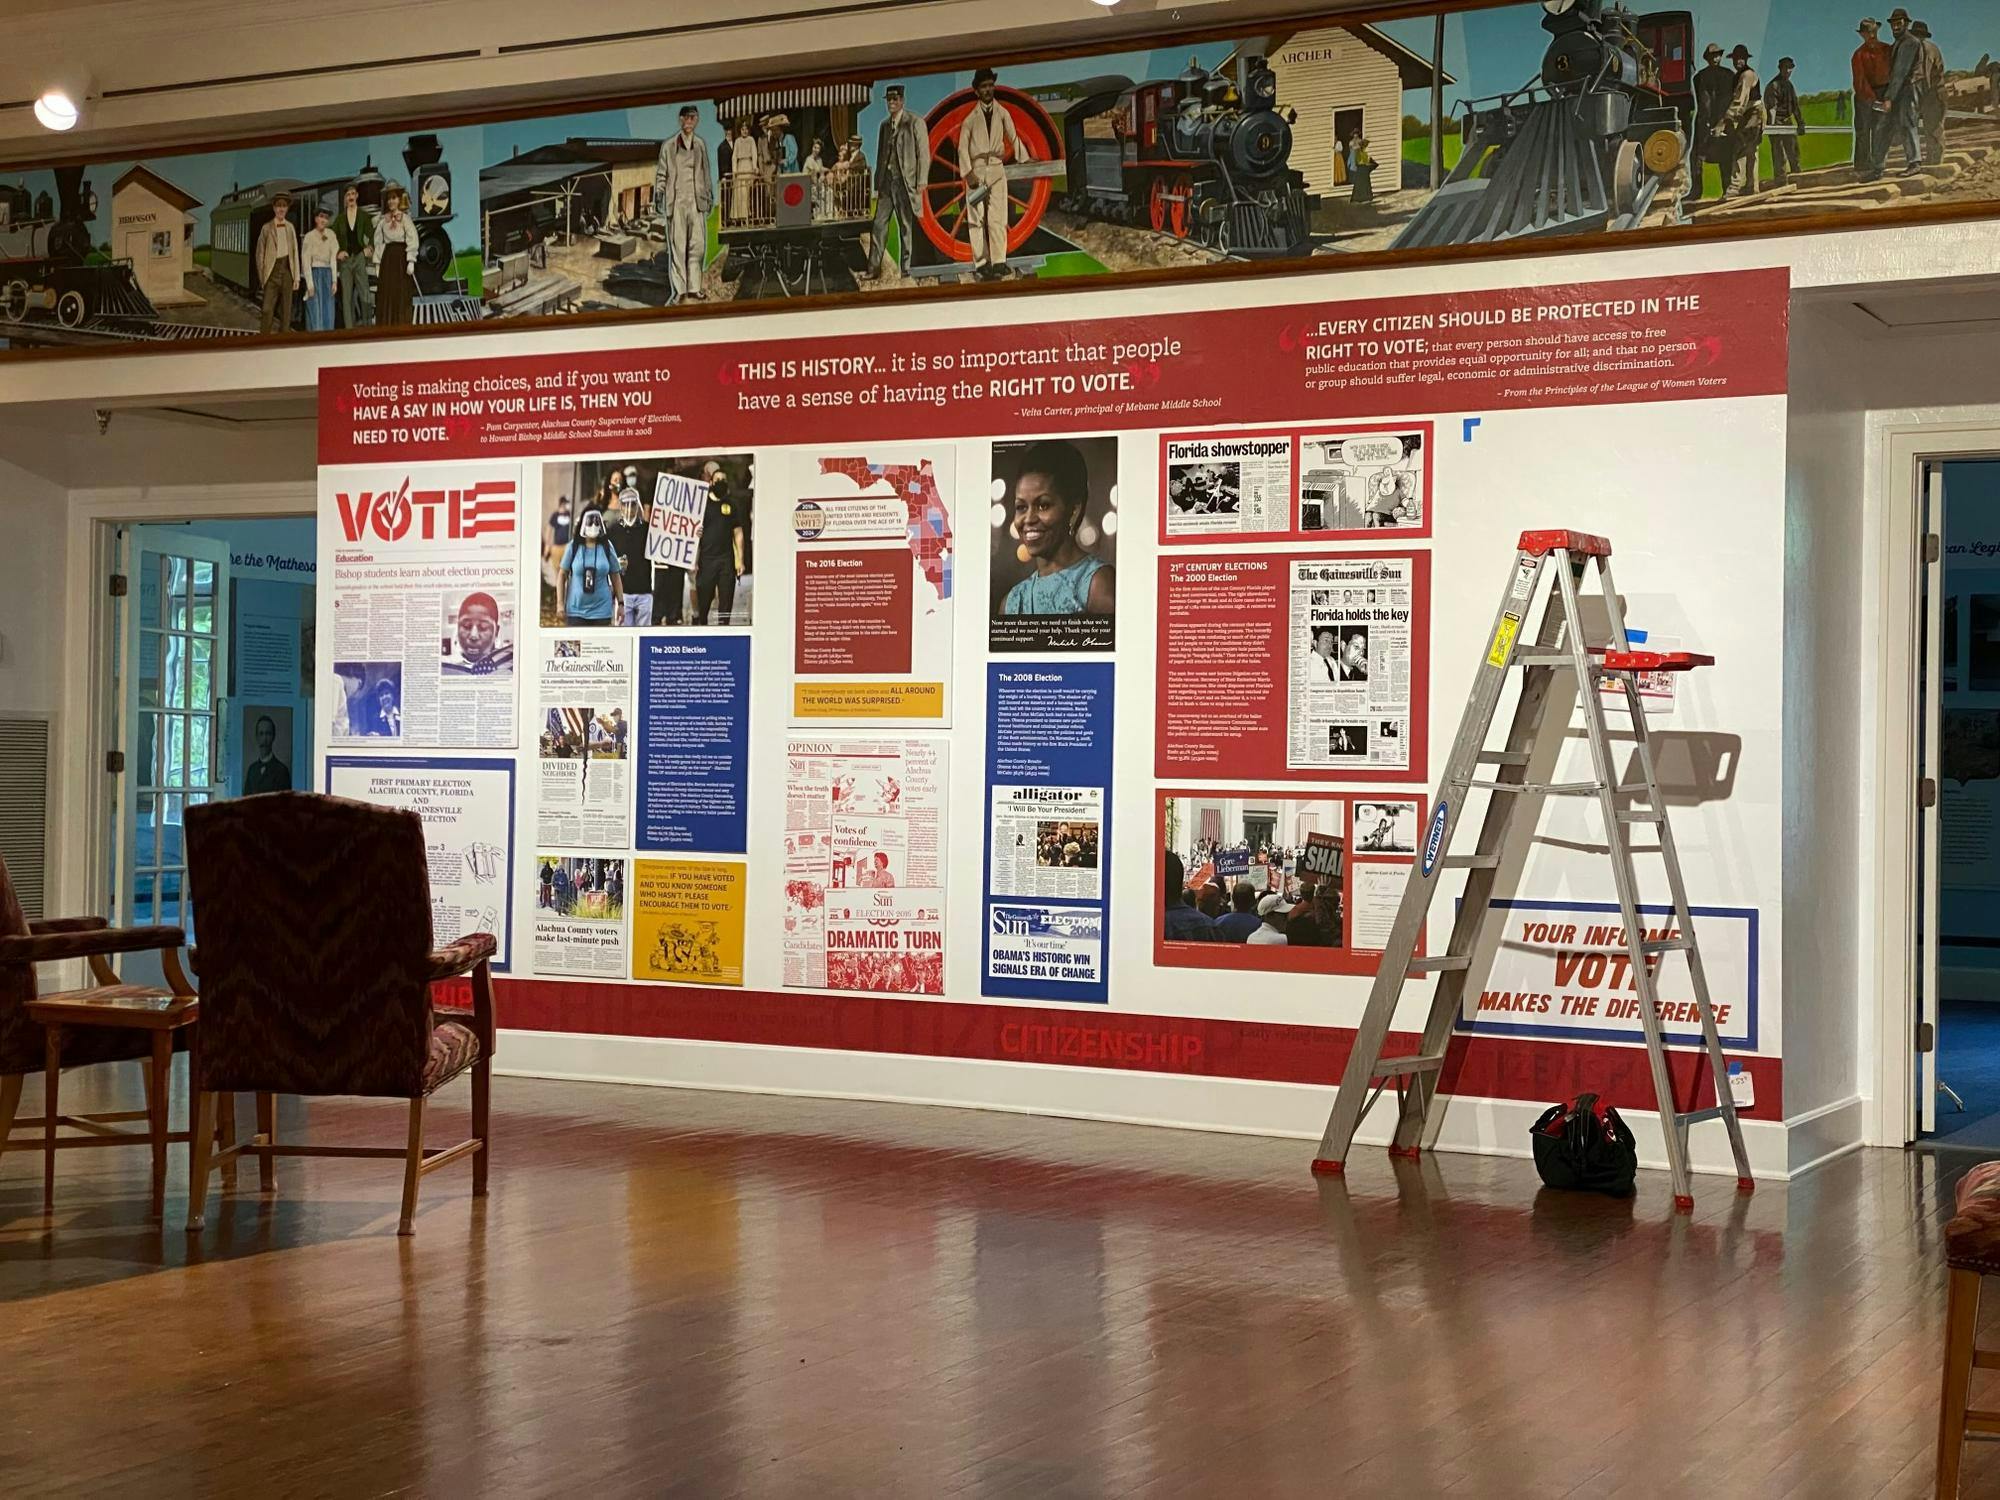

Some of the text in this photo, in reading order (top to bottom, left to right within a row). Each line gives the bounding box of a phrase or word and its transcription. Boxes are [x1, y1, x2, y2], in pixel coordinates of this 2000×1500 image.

[1281, 48, 1333, 64] ARCHER
[118, 212, 157, 226] BRONSON
[1306, 295, 1700, 336] ...EVERY CITIZEN SHOULD BE PROTECTED IN THE
[1306, 327, 1667, 359] RIGHT TO VOTE; that every person should have access to free
[738, 337, 1181, 380] THIS IS HISTORY... it is so important that people
[353, 369, 671, 401] Voting is making choices, and if you want to
[738, 372, 1135, 410] have a sense of having the RIGHT TO VOTE.
[353, 391, 652, 420] HAVE A SAY IN HOW YOUR LIFE IS, THEN YOU
[1043, 407, 1073, 416] Carter,
[1074, 404, 1114, 416] principal
[1114, 402, 1125, 414] of
[1125, 402, 1160, 412] Mebane
[1161, 399, 1191, 410] Middle
[1192, 397, 1222, 408] School
[353, 427, 449, 444] NEED TO VOTE.
[1169, 442, 1290, 459] Florida showstopper
[656, 475, 709, 515] COUNT
[336, 475, 516, 542] VOTE
[651, 508, 701, 538] EVERY
[649, 532, 695, 564] VOTE
[244, 553, 264, 567] the
[266, 554, 317, 573] Matheso
[335, 554, 374, 563] Education
[805, 559, 863, 568] The 2016 Election
[334, 567, 514, 580] Bishop students learn about election process
[1185, 563, 1223, 572] CENTURY
[1224, 562, 1268, 571] ELECTIONS
[1298, 567, 1401, 581] The Gainesville Sun
[1170, 574, 1238, 582] The 2000 Election
[1310, 608, 1409, 623] Florida holds the key
[650, 646, 707, 654] The 2020 Election
[546, 660, 624, 673] The Gainesville Sun
[998, 673, 1063, 682] The 2008 Election
[904, 686, 936, 694] AROUND
[787, 743, 833, 753] OPINION
[542, 762, 578, 771] DIVIDED
[371, 778, 472, 788] FIRST PRIMARY ELECTION
[368, 787, 474, 797] ALACHUA COUNTY, FLORIDA
[1013, 788, 1083, 803] alligator
[412, 797, 429, 805] AND
[834, 825, 868, 835] Votes of
[833, 836, 878, 848] confidence
[1426, 816, 1445, 862] WERNER
[536, 924, 619, 937] Alachua County voters
[993, 910, 1030, 936] Sun
[535, 935, 620, 947] make last-minute push
[826, 930, 942, 949] DRAMATIC TURN
[1522, 923, 1577, 945] YOUR
[783, 940, 823, 950] Candidates
[992, 950, 1091, 966] OBAMA'S HISTORIC WIN
[992, 963, 1096, 980] SIGNALS ERA OF CHANGE
[1477, 991, 1600, 1016] MAKES THE
[1000, 1022, 1201, 1066] CITIZENSHIP
